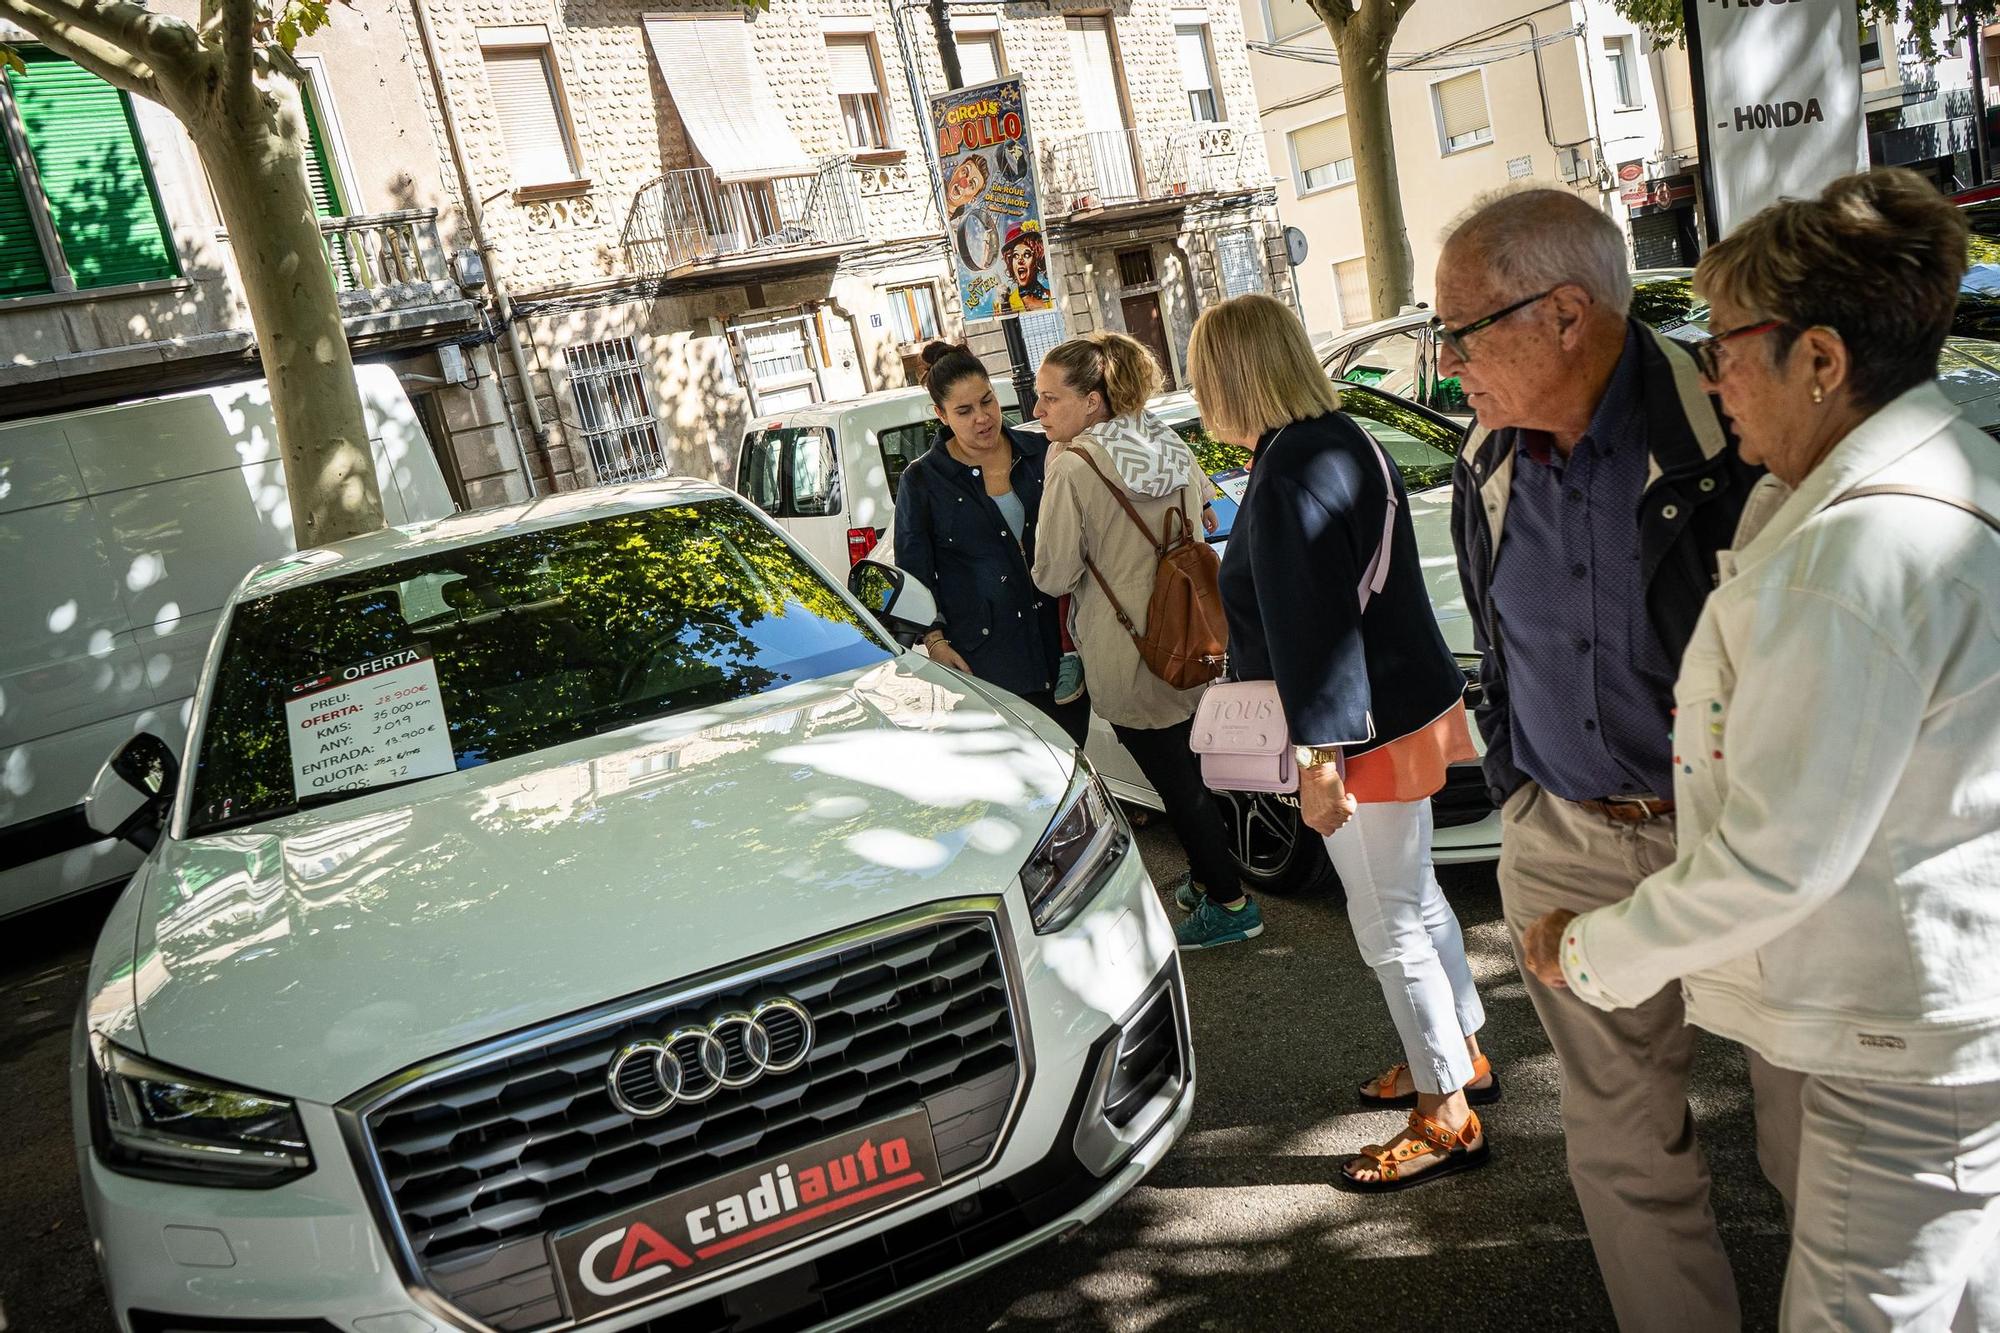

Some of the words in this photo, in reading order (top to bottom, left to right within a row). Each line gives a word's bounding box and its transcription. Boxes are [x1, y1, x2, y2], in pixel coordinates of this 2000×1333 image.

[946, 100, 999, 126] CIRCUS
[1734, 98, 1824, 132] HONDA
[939, 112, 1022, 157] APOLLO
[985, 193, 995, 202] DE
[1007, 198, 1030, 208] MORT
[1003, 186, 1025, 197] ROUE
[343, 649, 420, 680] OFERTA
[310, 693, 350, 711] PREU:
[1213, 700, 1274, 720] TOUS
[301, 704, 364, 729] OFERTA:
[317, 722, 351, 739] KMS:
[320, 736, 353, 753] ANY:
[302, 746, 374, 775] ENTRADA:
[390, 765, 408, 777] 72
[312, 763, 368, 787] QUOTA:
[685, 1137, 912, 1245] cadiauto
